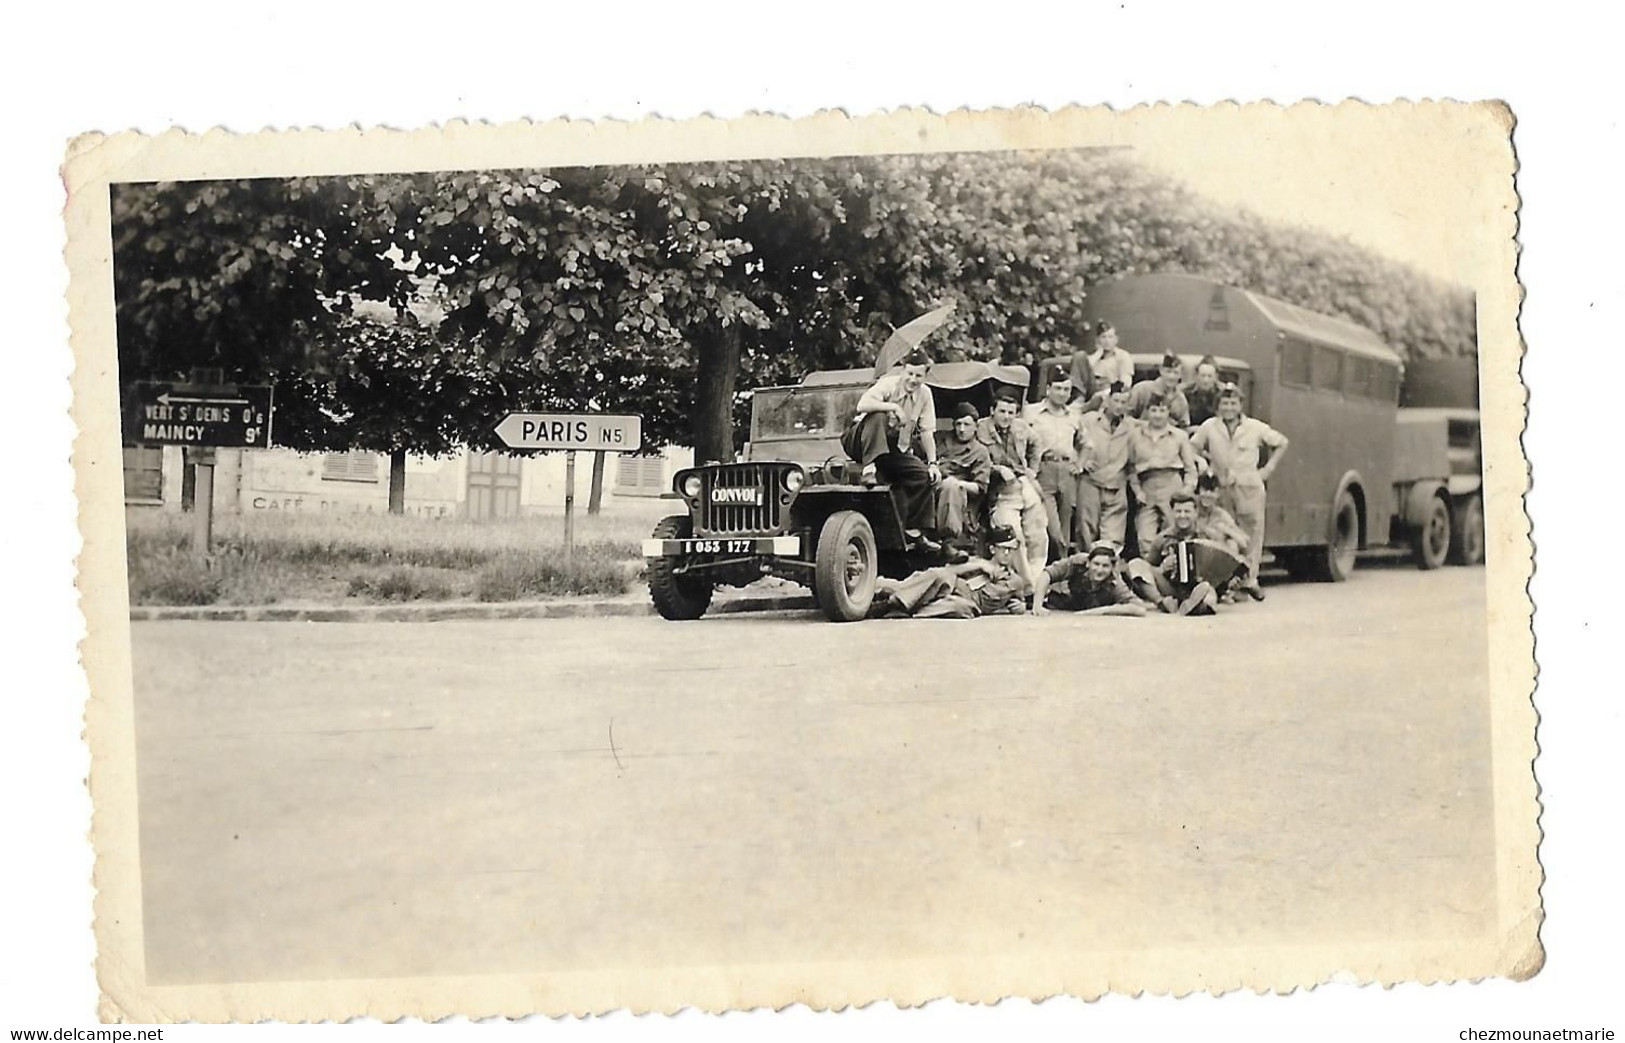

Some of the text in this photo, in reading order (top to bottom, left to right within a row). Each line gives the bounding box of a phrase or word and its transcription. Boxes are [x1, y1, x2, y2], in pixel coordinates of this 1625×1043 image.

[145, 405, 174, 421] VERT
[195, 407, 231, 423] DENIS
[143, 423, 205, 442] MAINCY
[522, 420, 622, 443] PARIS N5
[711, 487, 756, 503] CONVOI
[252, 495, 304, 511] CAFÉ
[320, 499, 339, 512] DE
[402, 503, 450, 521] AITÉ
[727, 540, 751, 553] 177
